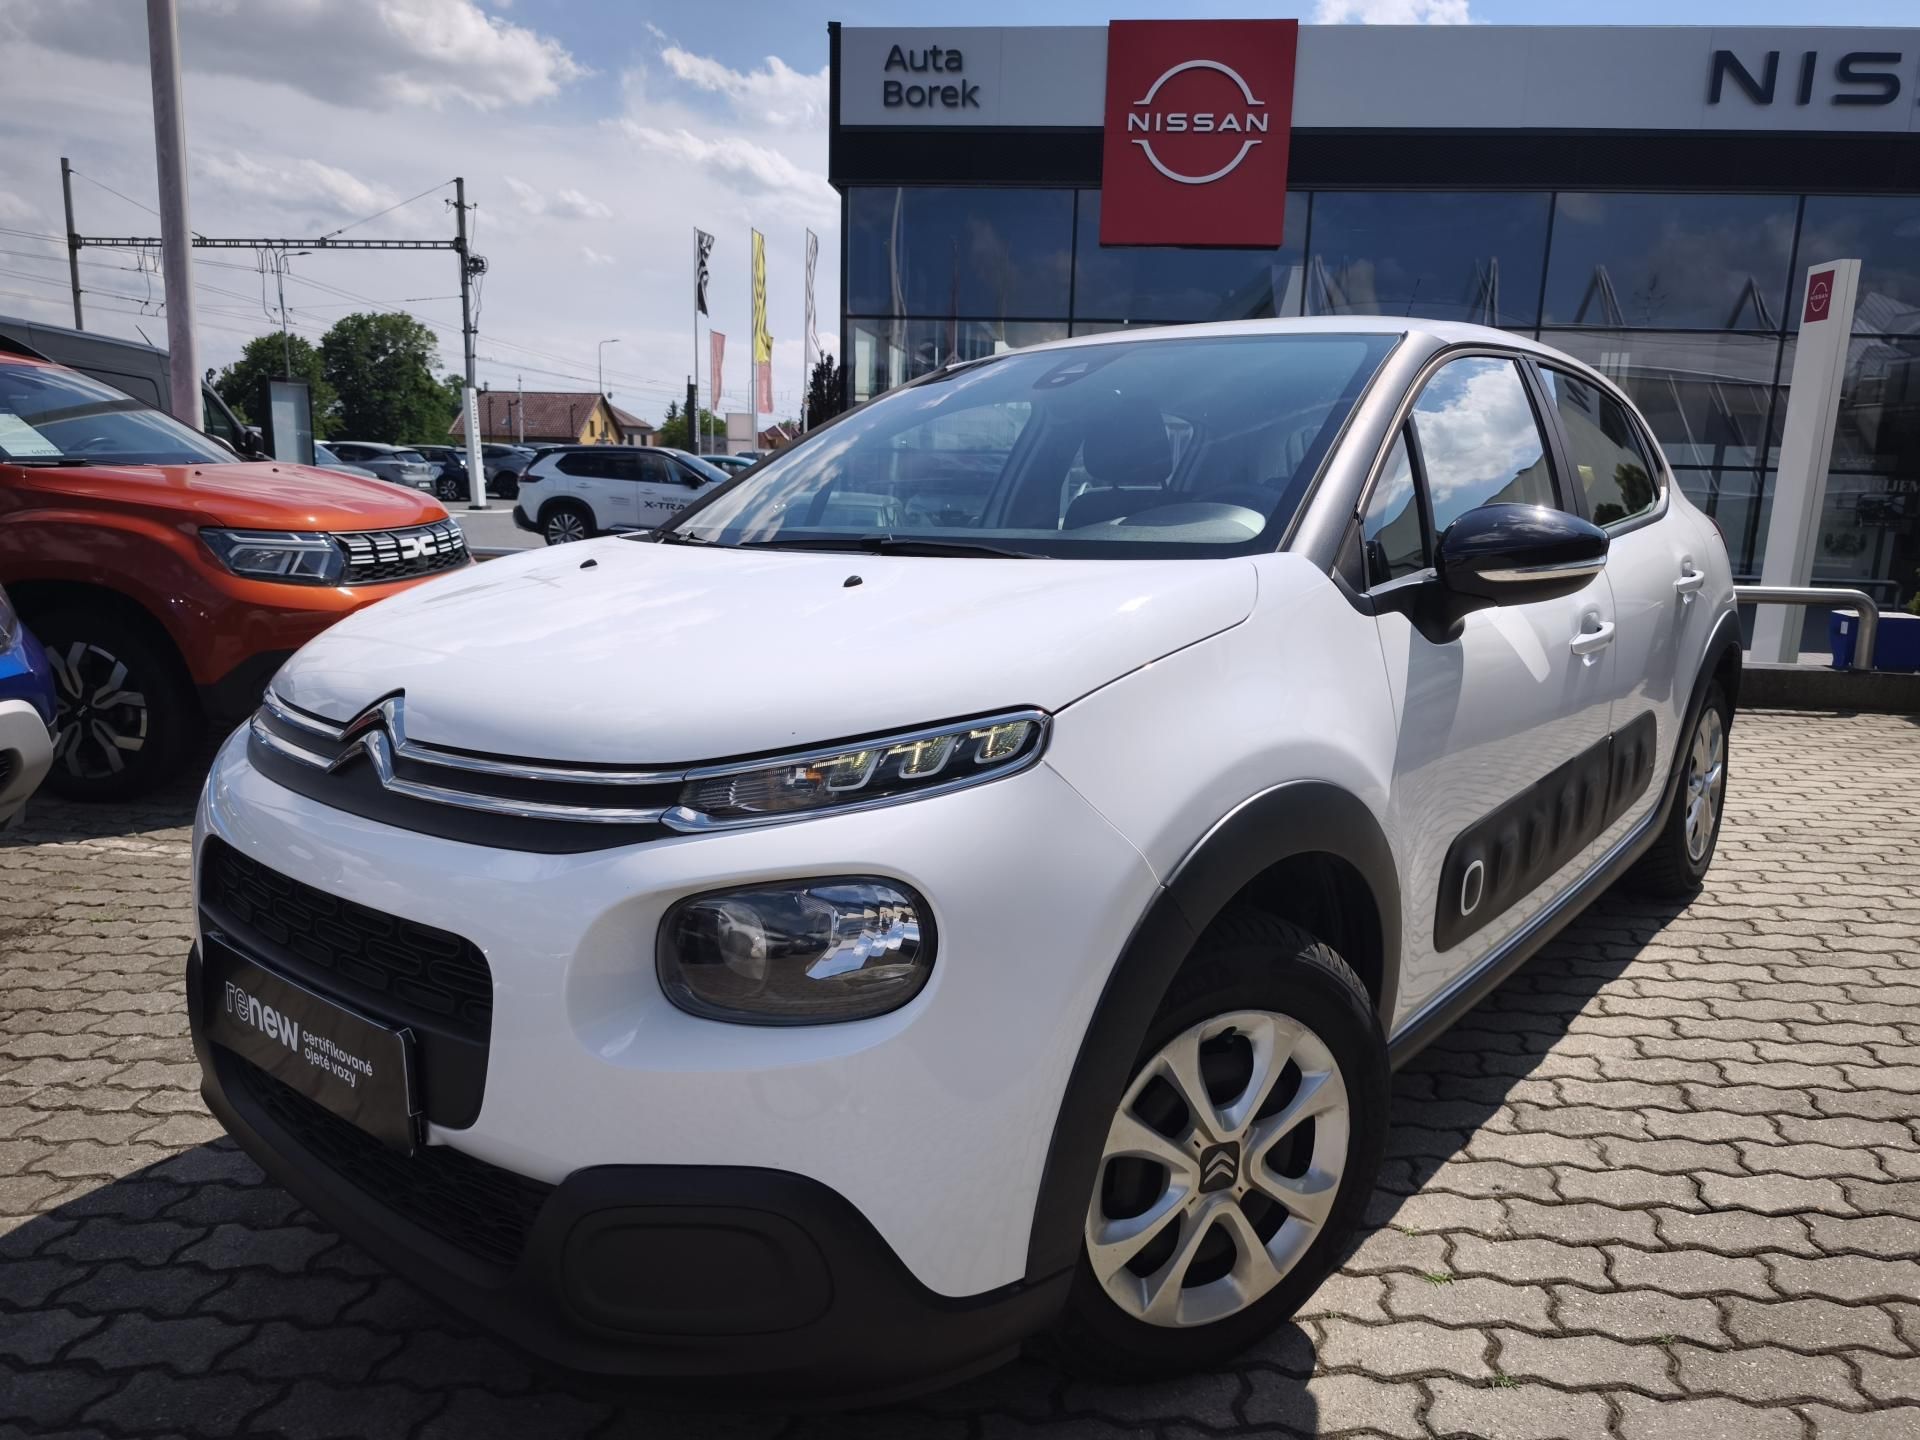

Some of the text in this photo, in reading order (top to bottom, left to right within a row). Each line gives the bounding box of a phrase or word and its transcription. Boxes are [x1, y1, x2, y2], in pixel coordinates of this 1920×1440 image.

[884, 43, 963, 73] Auta
[883, 79, 981, 109] Borek
[1707, 50, 1904, 106] NIS
[1127, 112, 1269, 133] NISSAN
[644, 500, 687, 511] X-TRA
[226, 981, 298, 1052] renew
[302, 1030, 373, 1077] certifikované
[304, 1047, 356, 1088] ojeté vozy
